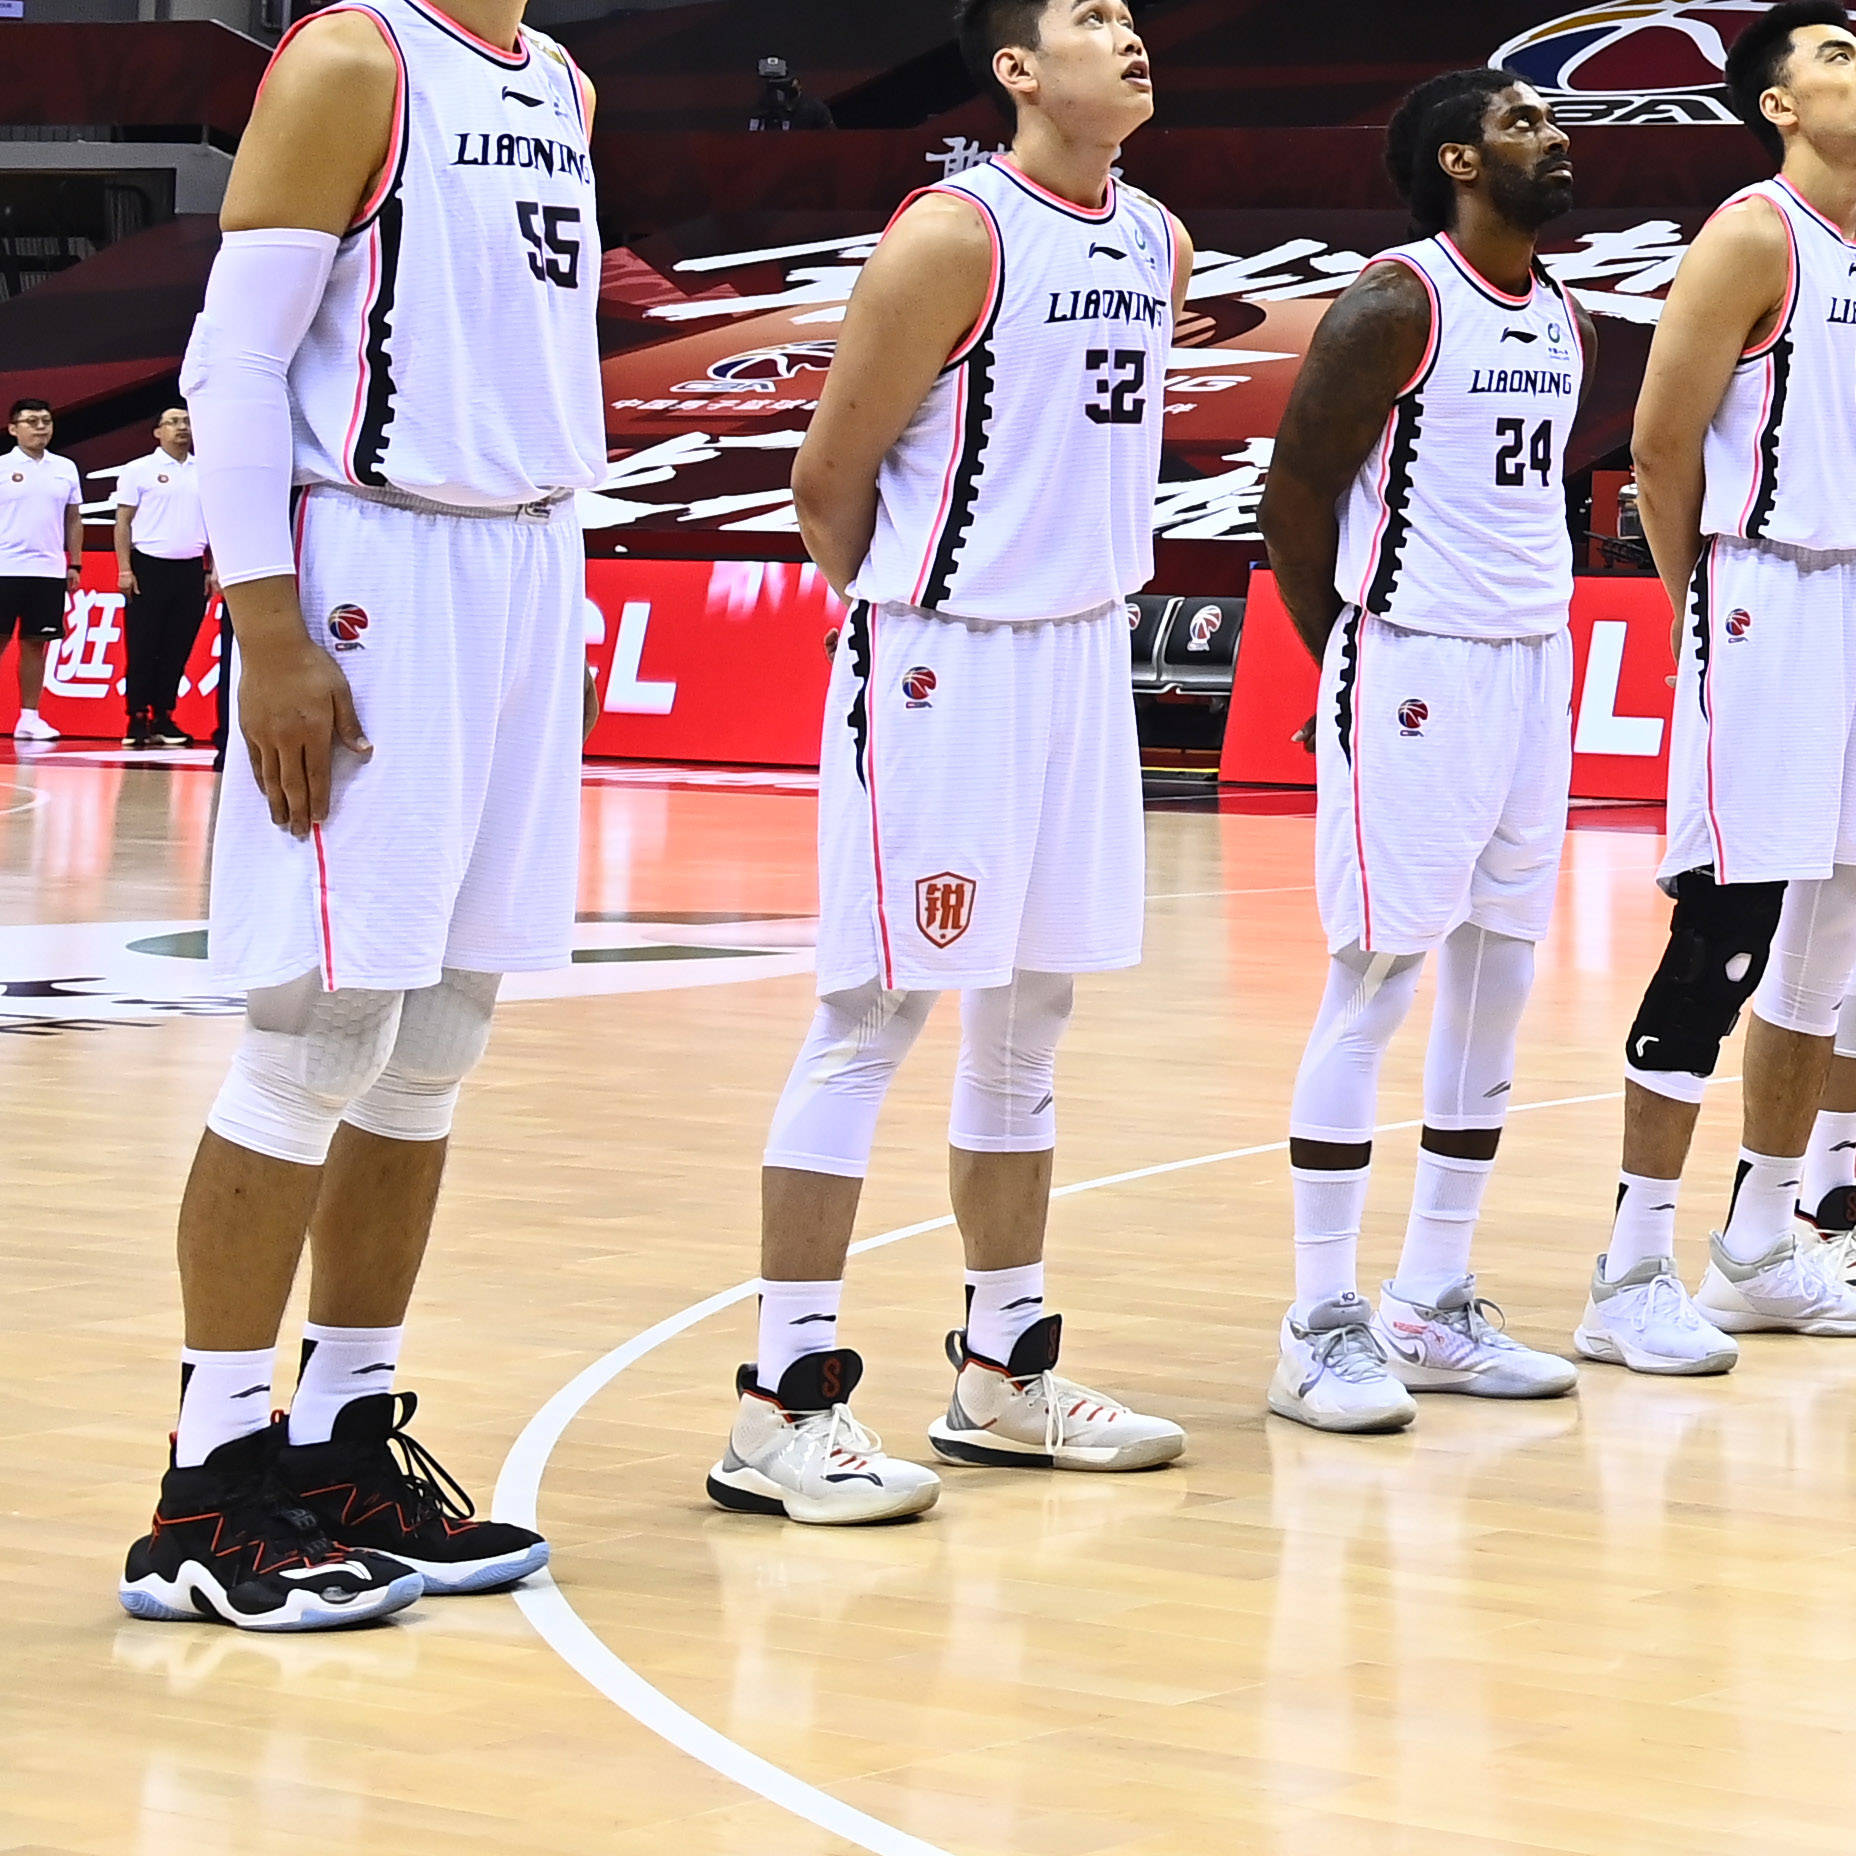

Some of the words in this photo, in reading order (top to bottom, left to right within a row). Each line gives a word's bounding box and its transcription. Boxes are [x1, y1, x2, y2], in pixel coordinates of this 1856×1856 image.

[1549, 94, 1745, 125] BA
[516, 201, 581, 289] 55
[1085, 349, 1147, 425] 32
[1469, 369, 1572, 396] LIAONING
[1495, 417, 1552, 487] 24
